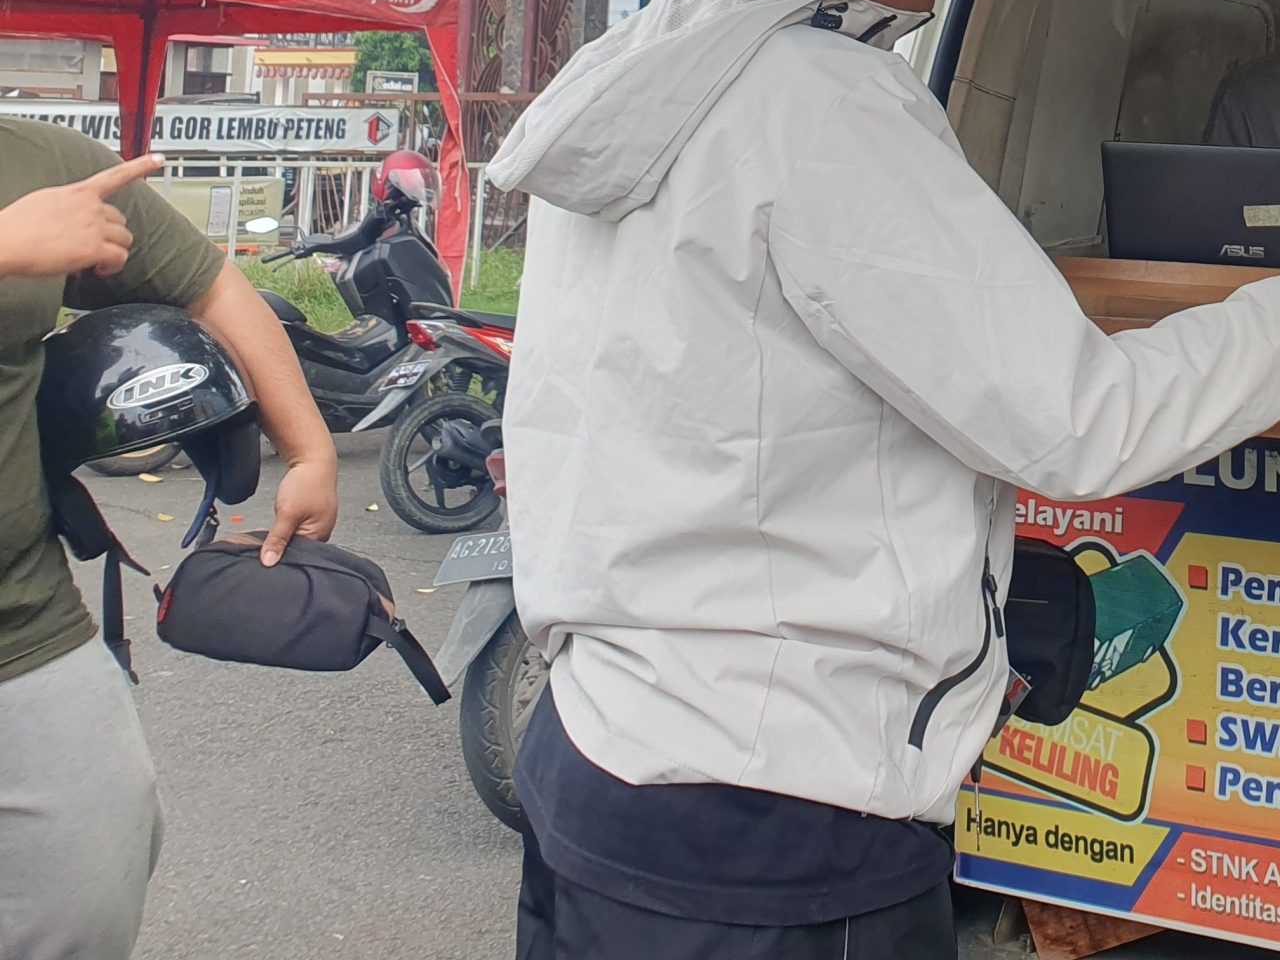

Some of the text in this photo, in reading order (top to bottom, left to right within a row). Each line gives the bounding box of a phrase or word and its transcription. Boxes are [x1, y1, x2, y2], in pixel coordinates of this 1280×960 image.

[170, 116, 211, 141] GOR
[216, 117, 278, 141] LEMBU
[283, 117, 346, 141] PETENG
[1219, 244, 1264, 258] ASUS
[122, 366, 202, 403] INK
[448, 540, 474, 560] AG
[999, 724, 1120, 801] KELILING
[966, 808, 1135, 864] Hanya dengan
[1190, 848, 1260, 883] STNK
